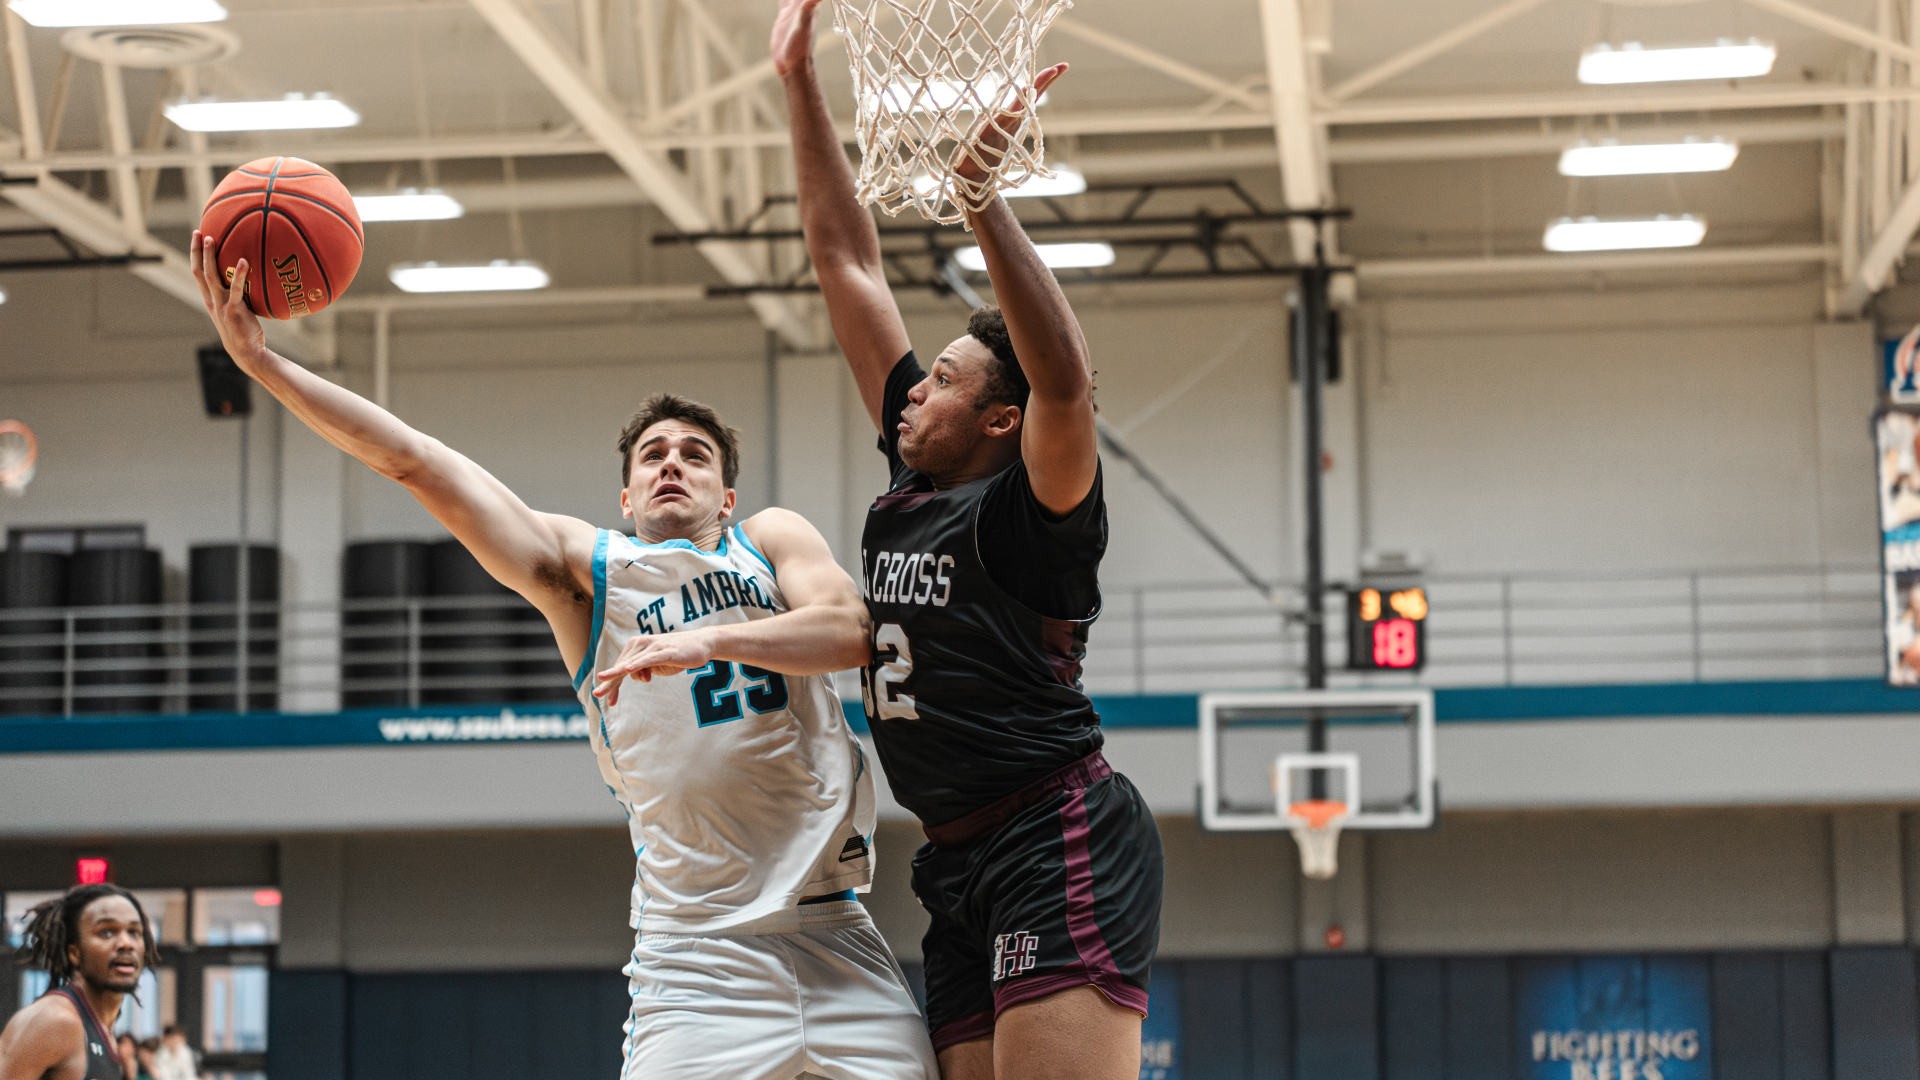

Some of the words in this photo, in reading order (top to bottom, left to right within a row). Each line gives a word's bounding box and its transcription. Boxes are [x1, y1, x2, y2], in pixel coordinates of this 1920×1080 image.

[272, 253, 311, 318] SPALD
[636, 596, 675, 635] ST.
[680, 570, 777, 624] AMBRO
[873, 551, 955, 607] CROSS
[1373, 618, 1417, 668] 18
[1532, 1029, 1699, 1062] FIGHTING
